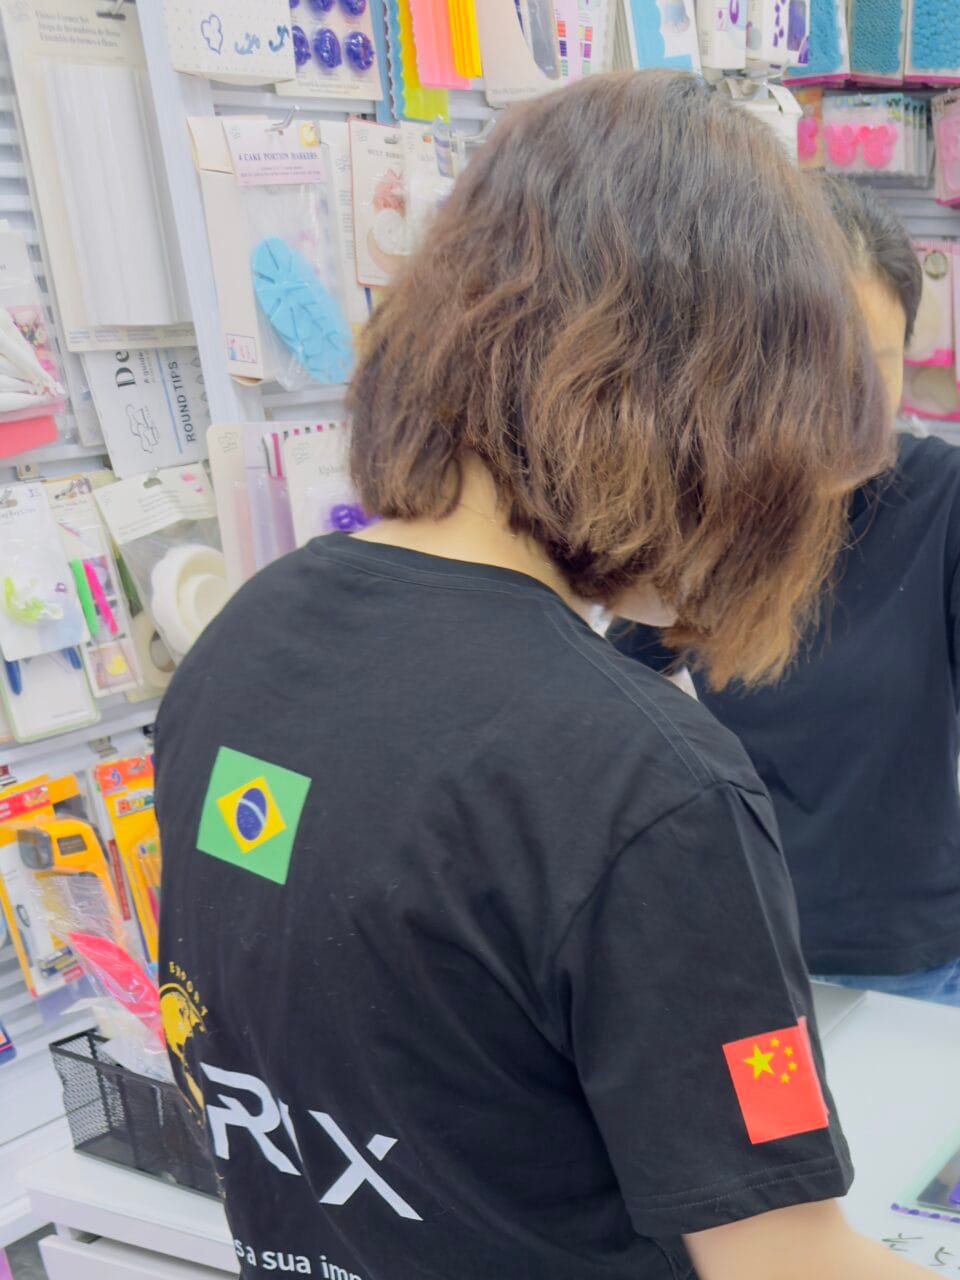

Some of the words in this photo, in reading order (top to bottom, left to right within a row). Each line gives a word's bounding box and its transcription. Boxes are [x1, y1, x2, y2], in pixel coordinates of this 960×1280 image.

[244, 153, 261, 161] CAKE
[167, 361, 184, 391] TIPS
[176, 394, 197, 443] ROUND
[261, 1250, 312, 1275] sua
